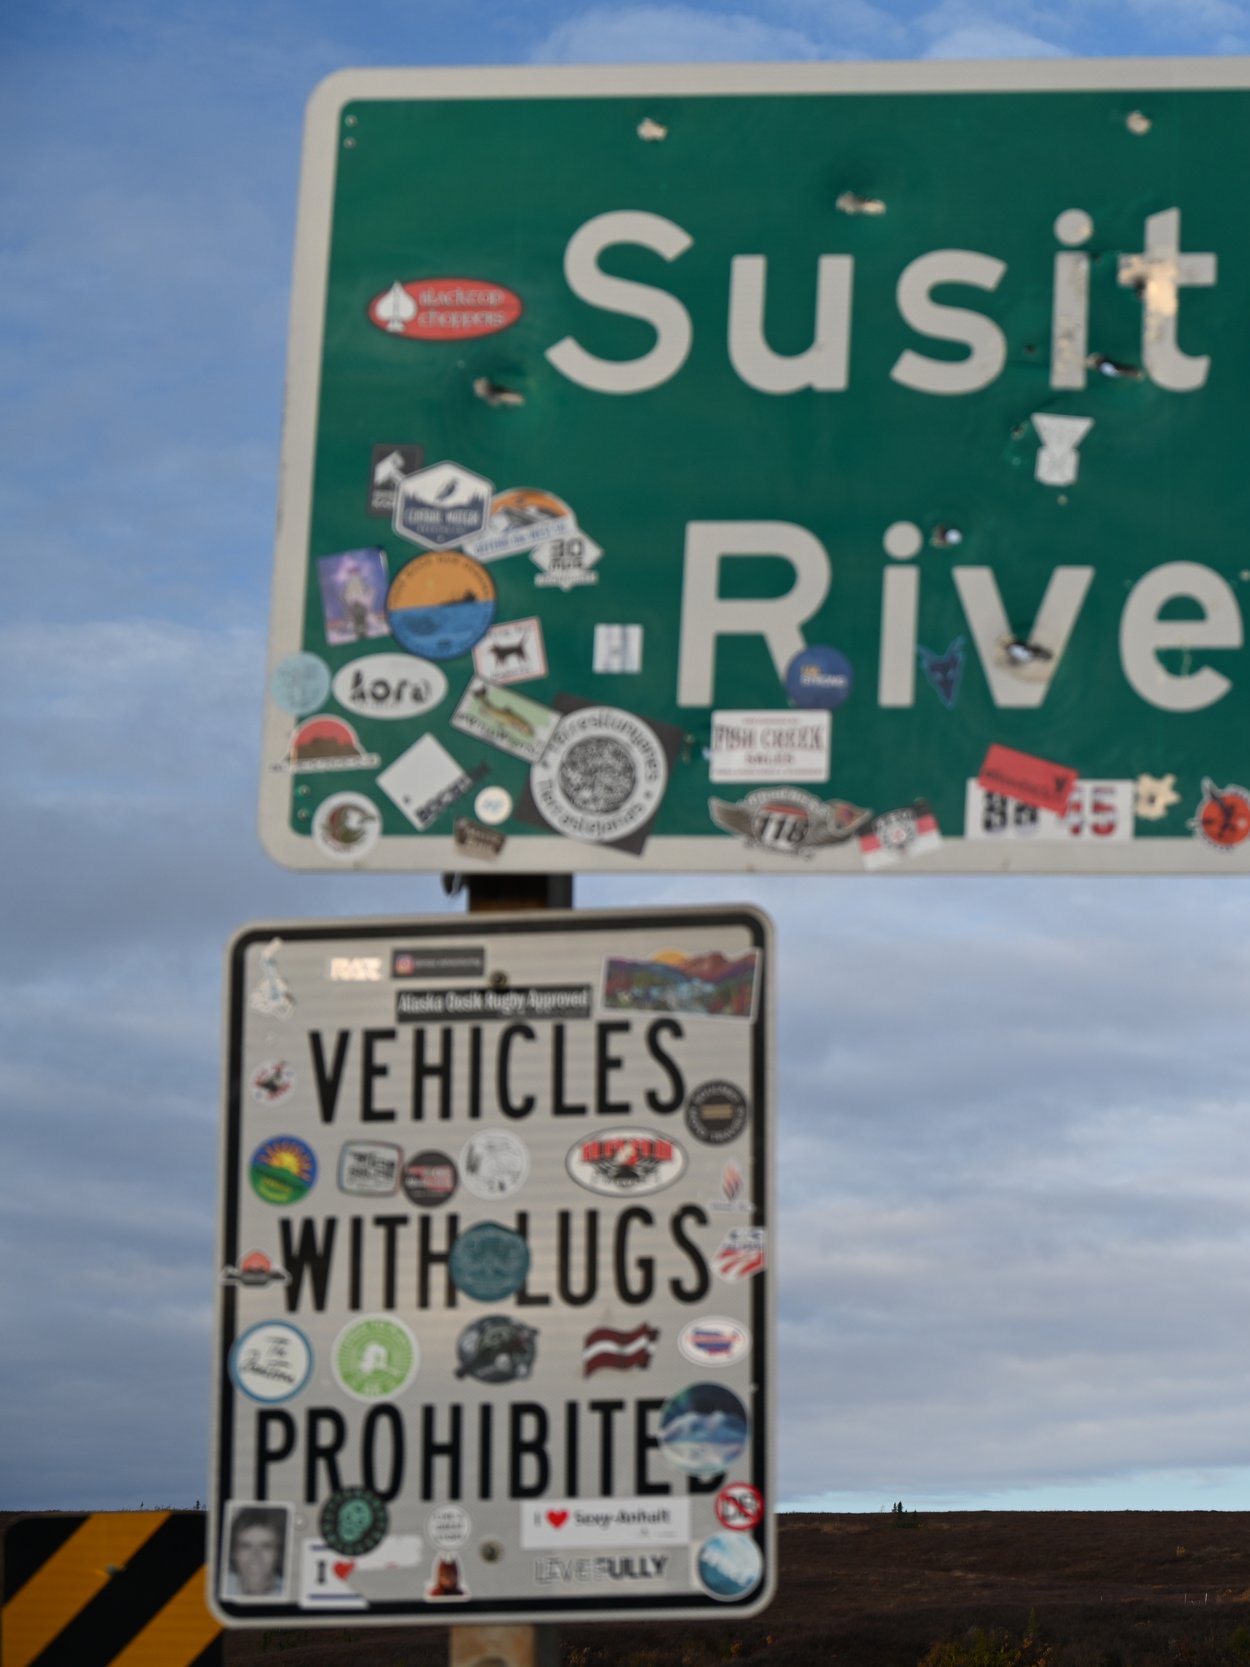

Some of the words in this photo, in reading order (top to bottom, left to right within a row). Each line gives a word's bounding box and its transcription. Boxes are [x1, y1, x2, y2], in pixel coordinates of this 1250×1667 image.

[714, 724, 756, 752] FISH
[759, 724, 824, 752] CREEK
[398, 993, 443, 1014] Alaska
[484, 990, 525, 1016] Rugby
[526, 989, 590, 1015] Approved
[308, 1017, 685, 1124] VEHICLES
[278, 1212, 460, 1314] WITH
[514, 1203, 711, 1308] LUGS
[255, 1399, 730, 1505] PROHIBITE
[316, 1560, 327, 1585] I
